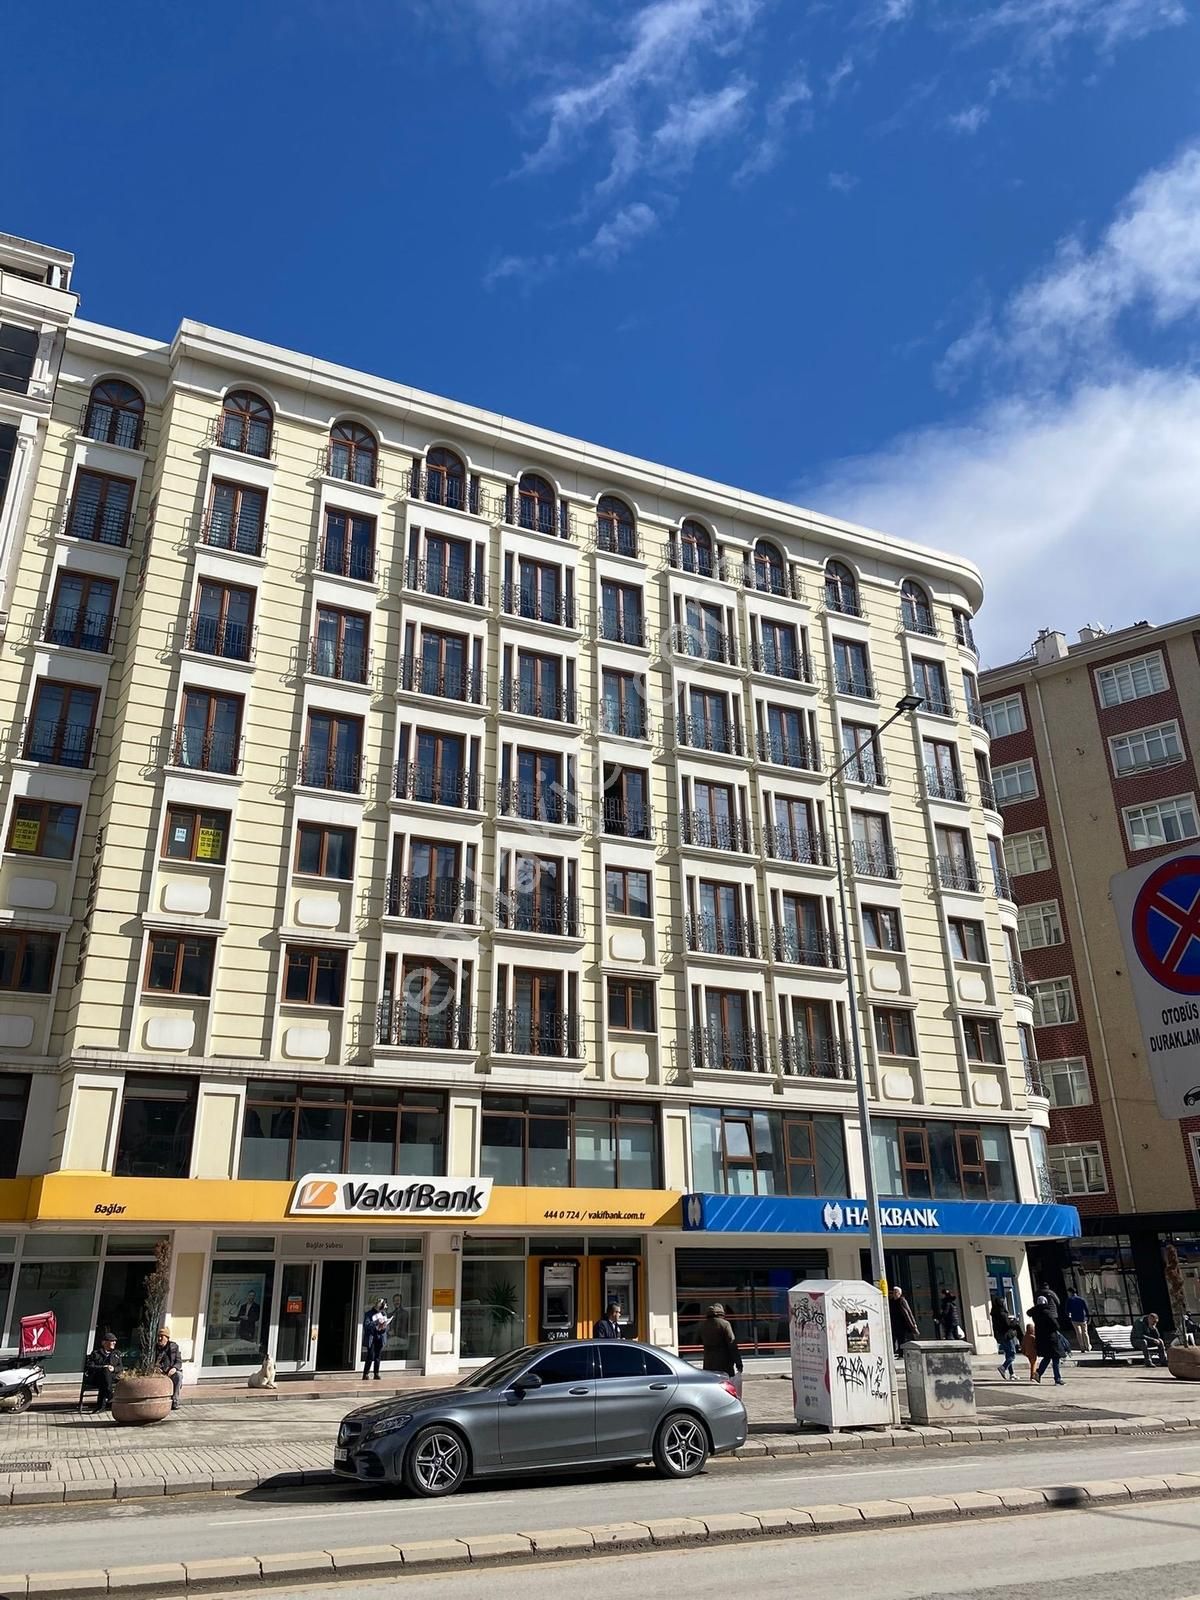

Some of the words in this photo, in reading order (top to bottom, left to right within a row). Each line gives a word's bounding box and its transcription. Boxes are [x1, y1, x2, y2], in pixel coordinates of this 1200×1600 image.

[1161, 1001, 1199, 1025] OTOBÜS
[342, 1182, 485, 1213] VakıfBank
[93, 1203, 127, 1216] Bağlar
[543, 1210, 558, 1219] 444
[559, 1210, 565, 1219] 0
[566, 1210, 580, 1219] 724
[588, 1210, 645, 1220] vakifbank.com.tr
[845, 1206, 940, 1227] HAKBANK
[305, 1241, 324, 1250] Bağlar
[325, 1241, 344, 1249] Şubesi
